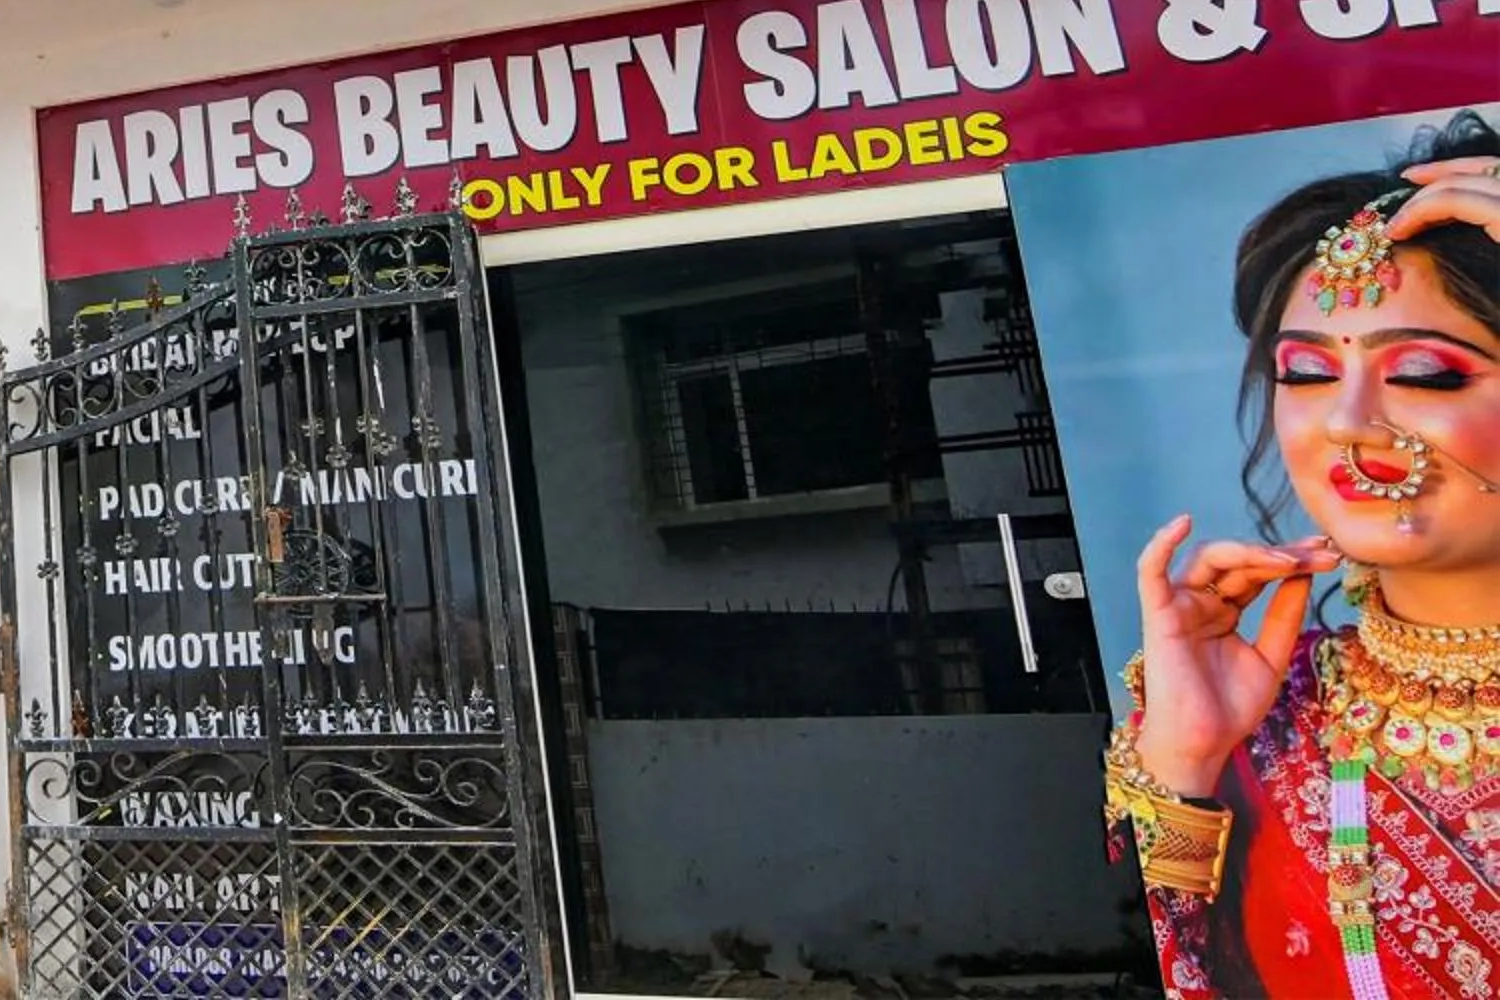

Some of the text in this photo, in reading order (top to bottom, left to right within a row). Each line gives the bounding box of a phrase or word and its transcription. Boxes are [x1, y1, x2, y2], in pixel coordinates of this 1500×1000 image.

[69, 88, 315, 213] ARIES
[333, 22, 706, 180] BEAUTY
[460, 111, 1009, 220] ONLY FOR LADEIS
[104, 558, 183, 595] HAIR
